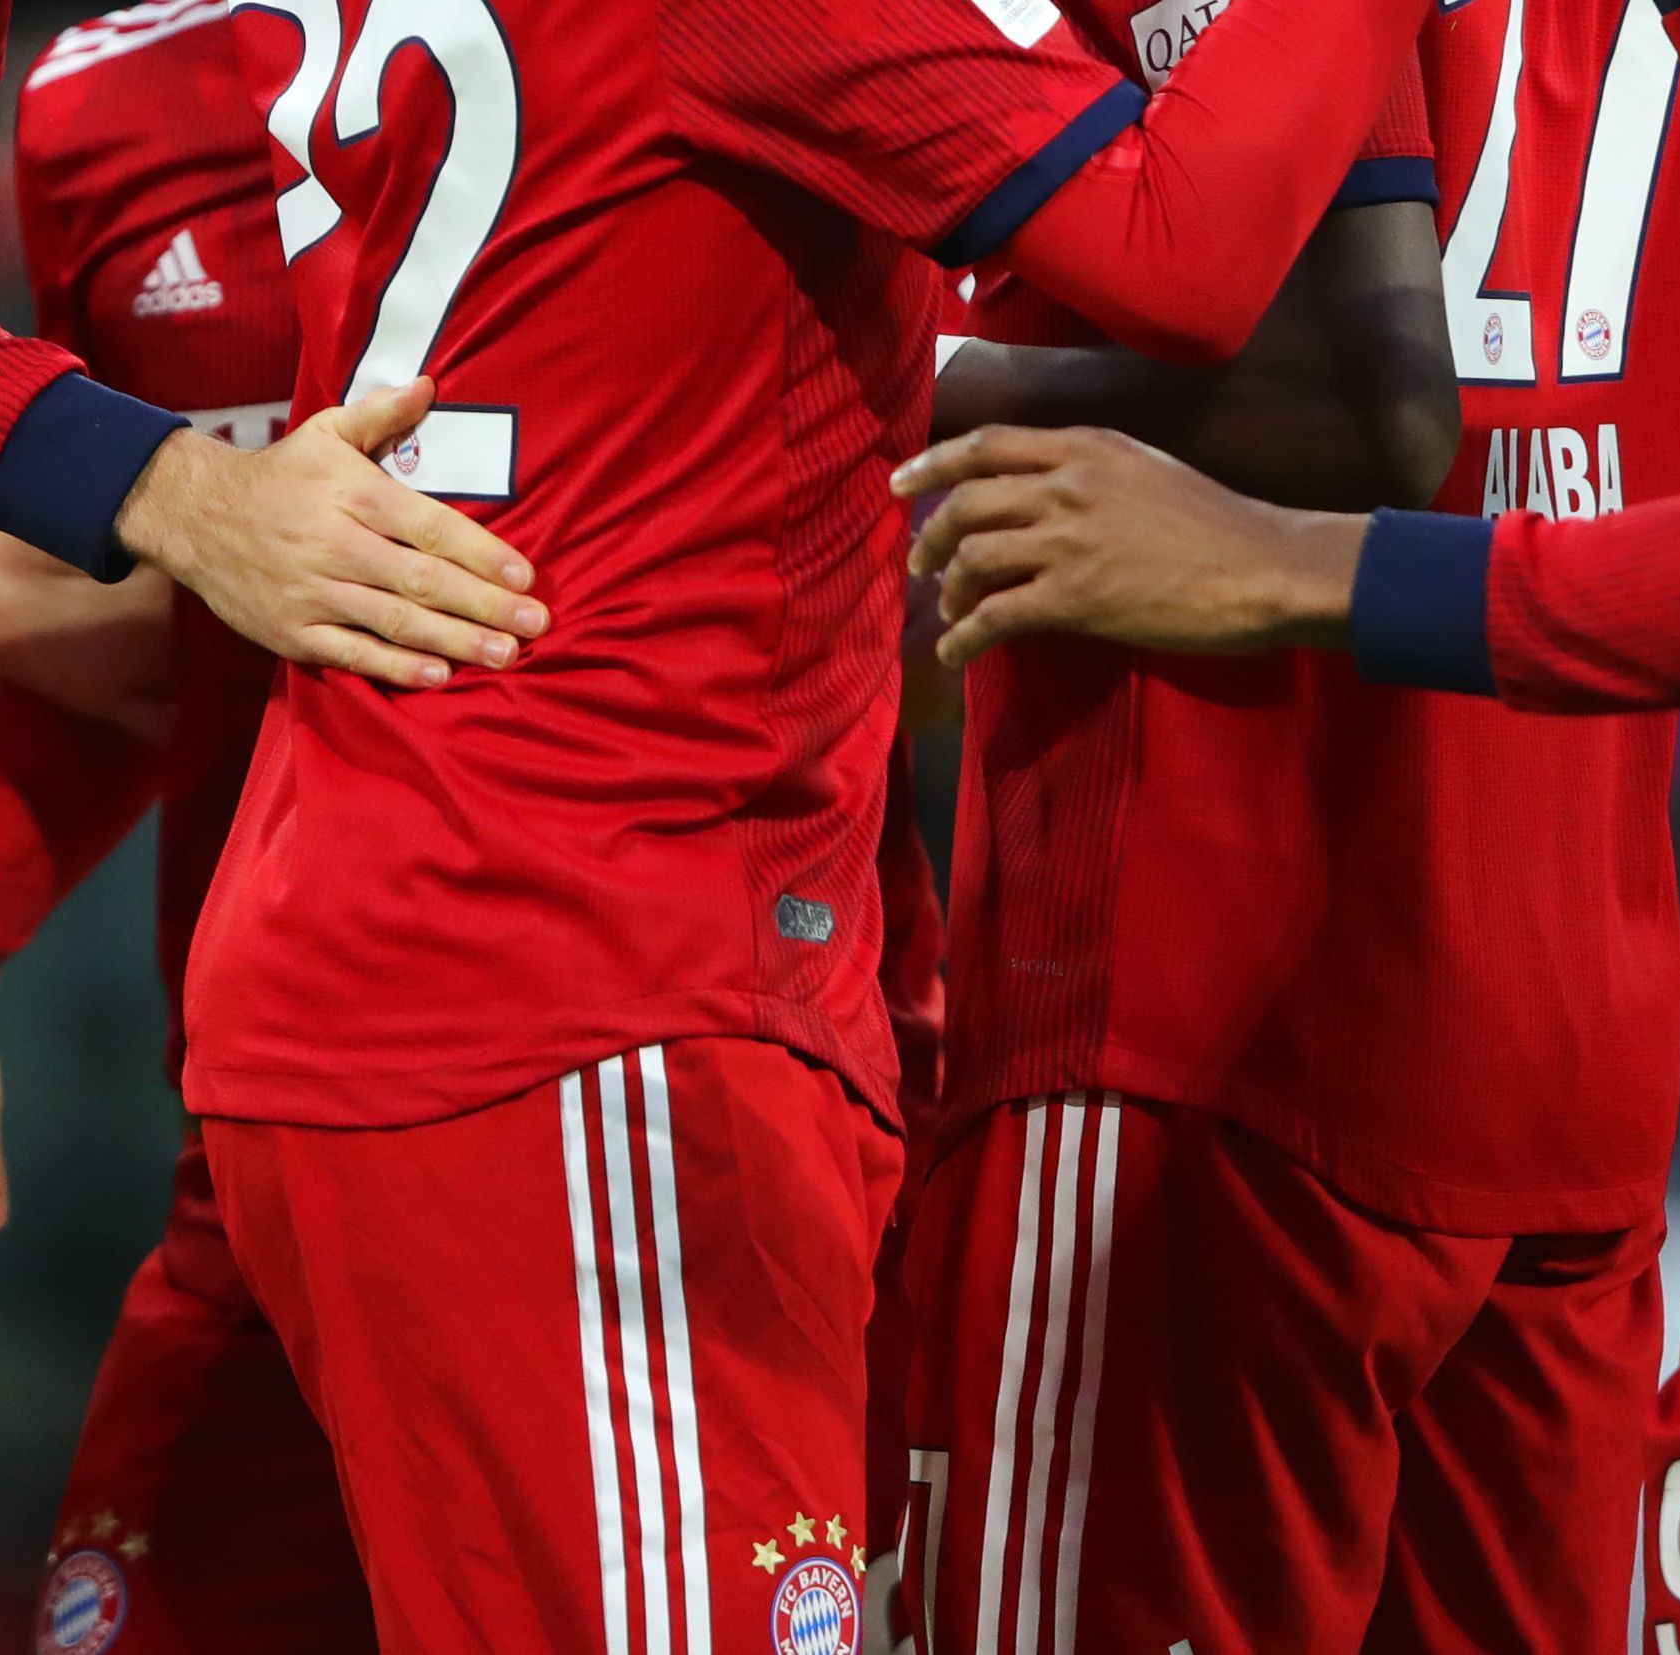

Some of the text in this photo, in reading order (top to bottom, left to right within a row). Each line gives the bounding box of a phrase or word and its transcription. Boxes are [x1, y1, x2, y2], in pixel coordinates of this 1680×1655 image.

[132, 280, 223, 318] adidas
[779, 1567, 853, 1619] FC BAYERN
